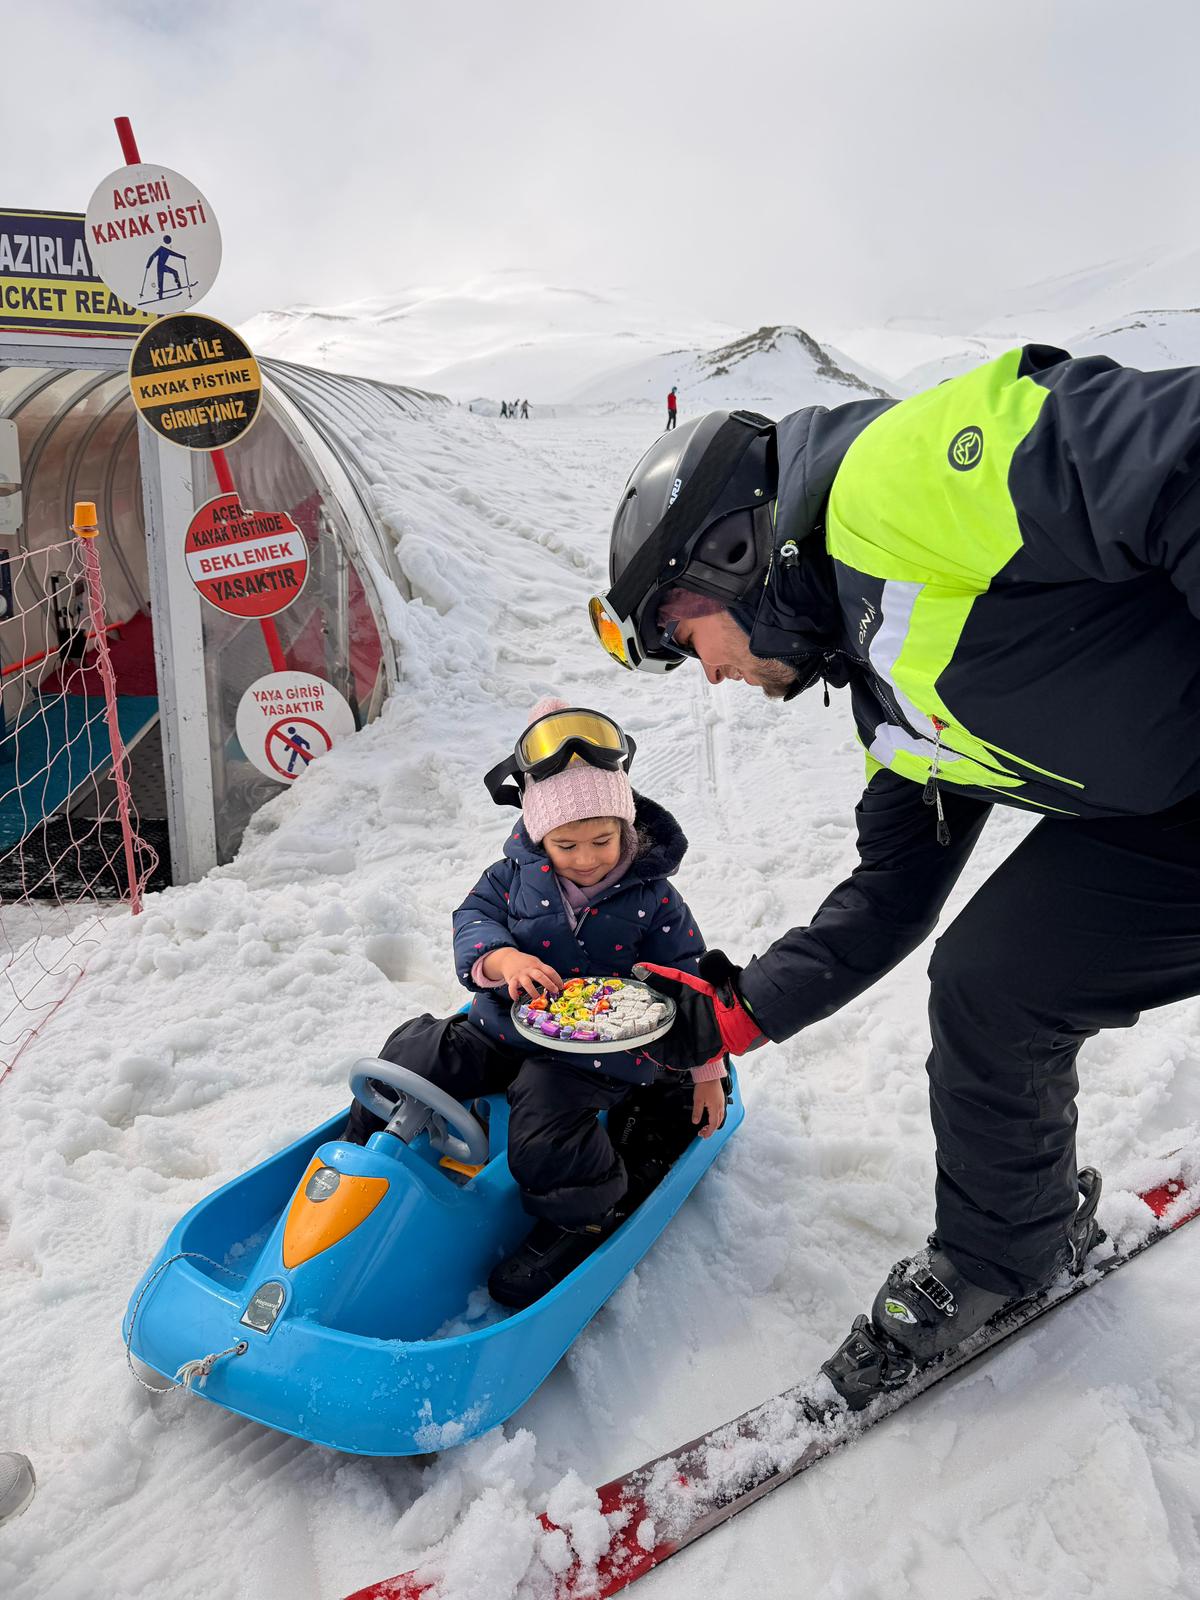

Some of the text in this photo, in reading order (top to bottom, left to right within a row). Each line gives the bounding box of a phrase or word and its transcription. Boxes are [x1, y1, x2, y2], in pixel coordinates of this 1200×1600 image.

[113, 175, 171, 210] ACEMİ
[92, 199, 207, 245] KAYAK PİSTİ
[0, 233, 100, 277] AZIRLA
[75, 290, 148, 317] READ
[150, 337, 225, 368] KIZAK İLE
[140, 369, 251, 399] KAYAK PİSTİNE
[161, 398, 247, 431] GİRMEYİNİZ
[192, 515, 283, 547] KAYAK PİSTİNDE
[200, 542, 293, 574] BEKLEMEK
[210, 567, 298, 602] YASAKTIR
[252, 682, 325, 702] YAYA GİRİŞİ
[260, 700, 324, 716] YASAKTIR
